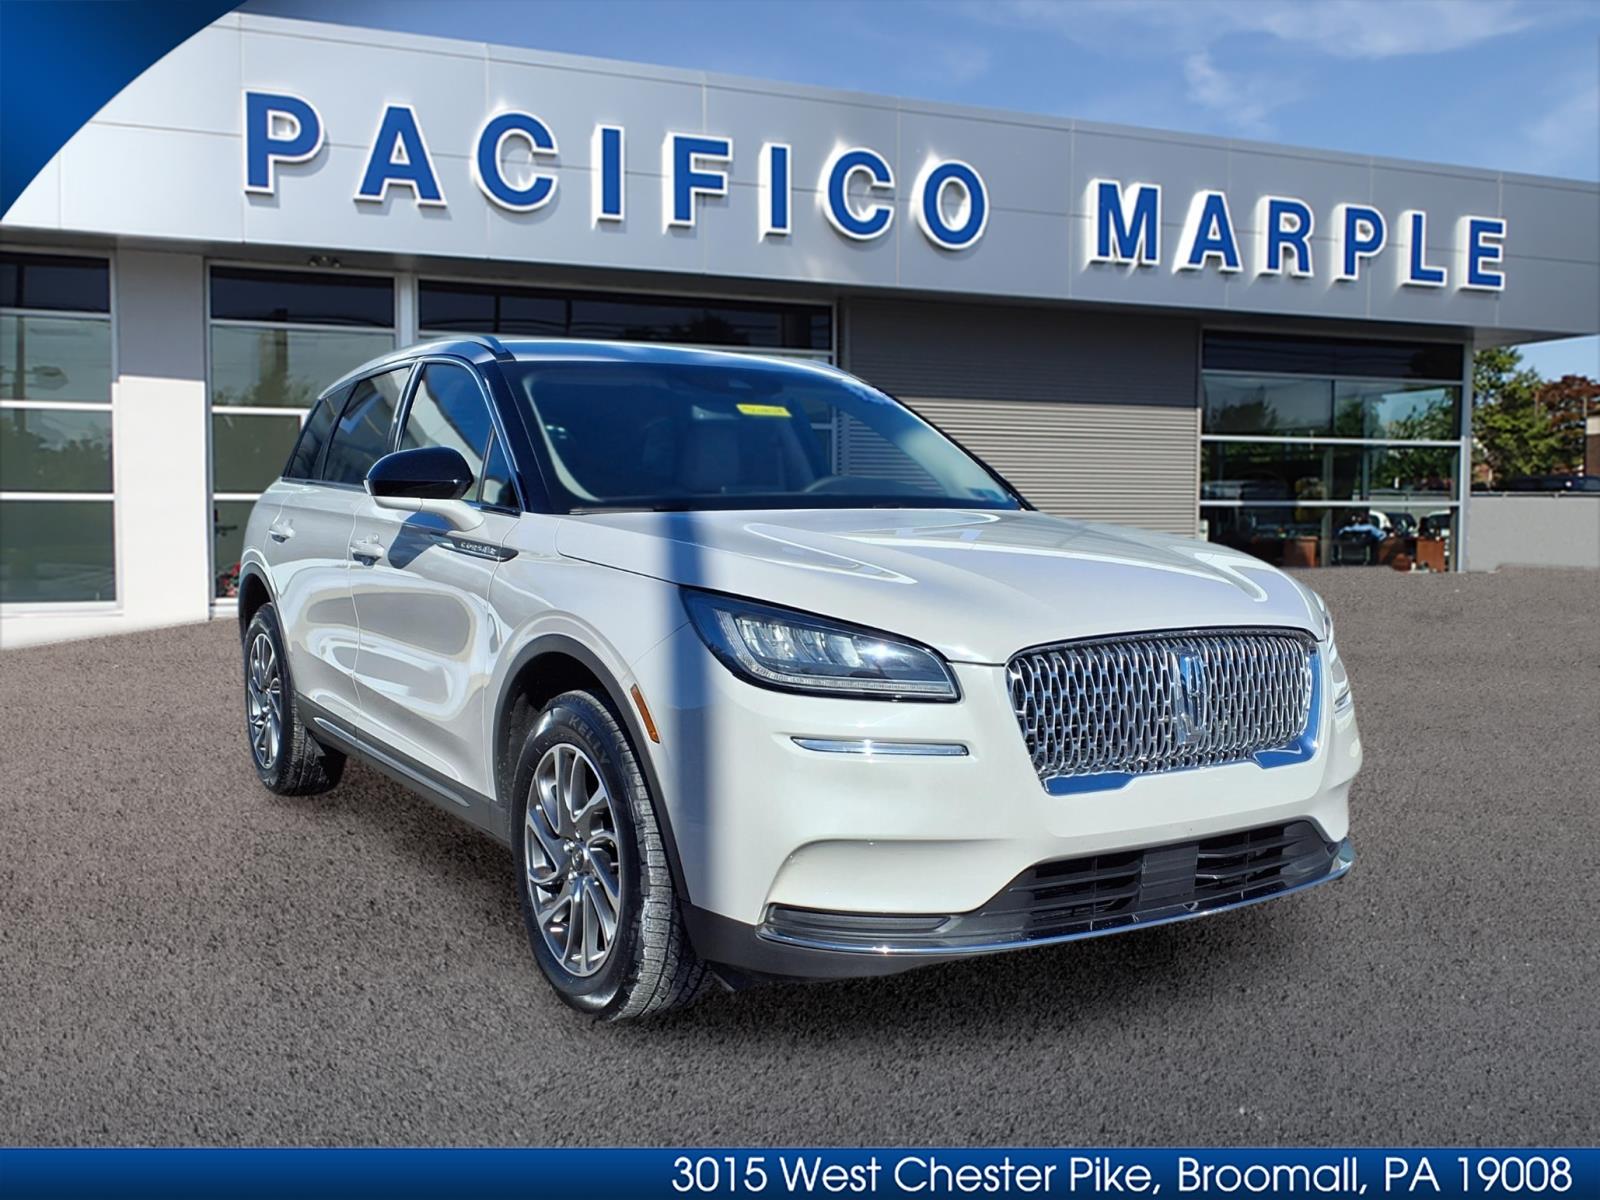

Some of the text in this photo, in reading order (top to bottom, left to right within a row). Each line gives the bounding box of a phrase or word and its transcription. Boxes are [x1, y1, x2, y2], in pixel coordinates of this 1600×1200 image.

[242, 89, 1507, 291] PACIFICO MARPLE
[568, 713, 611, 766] KELLY
